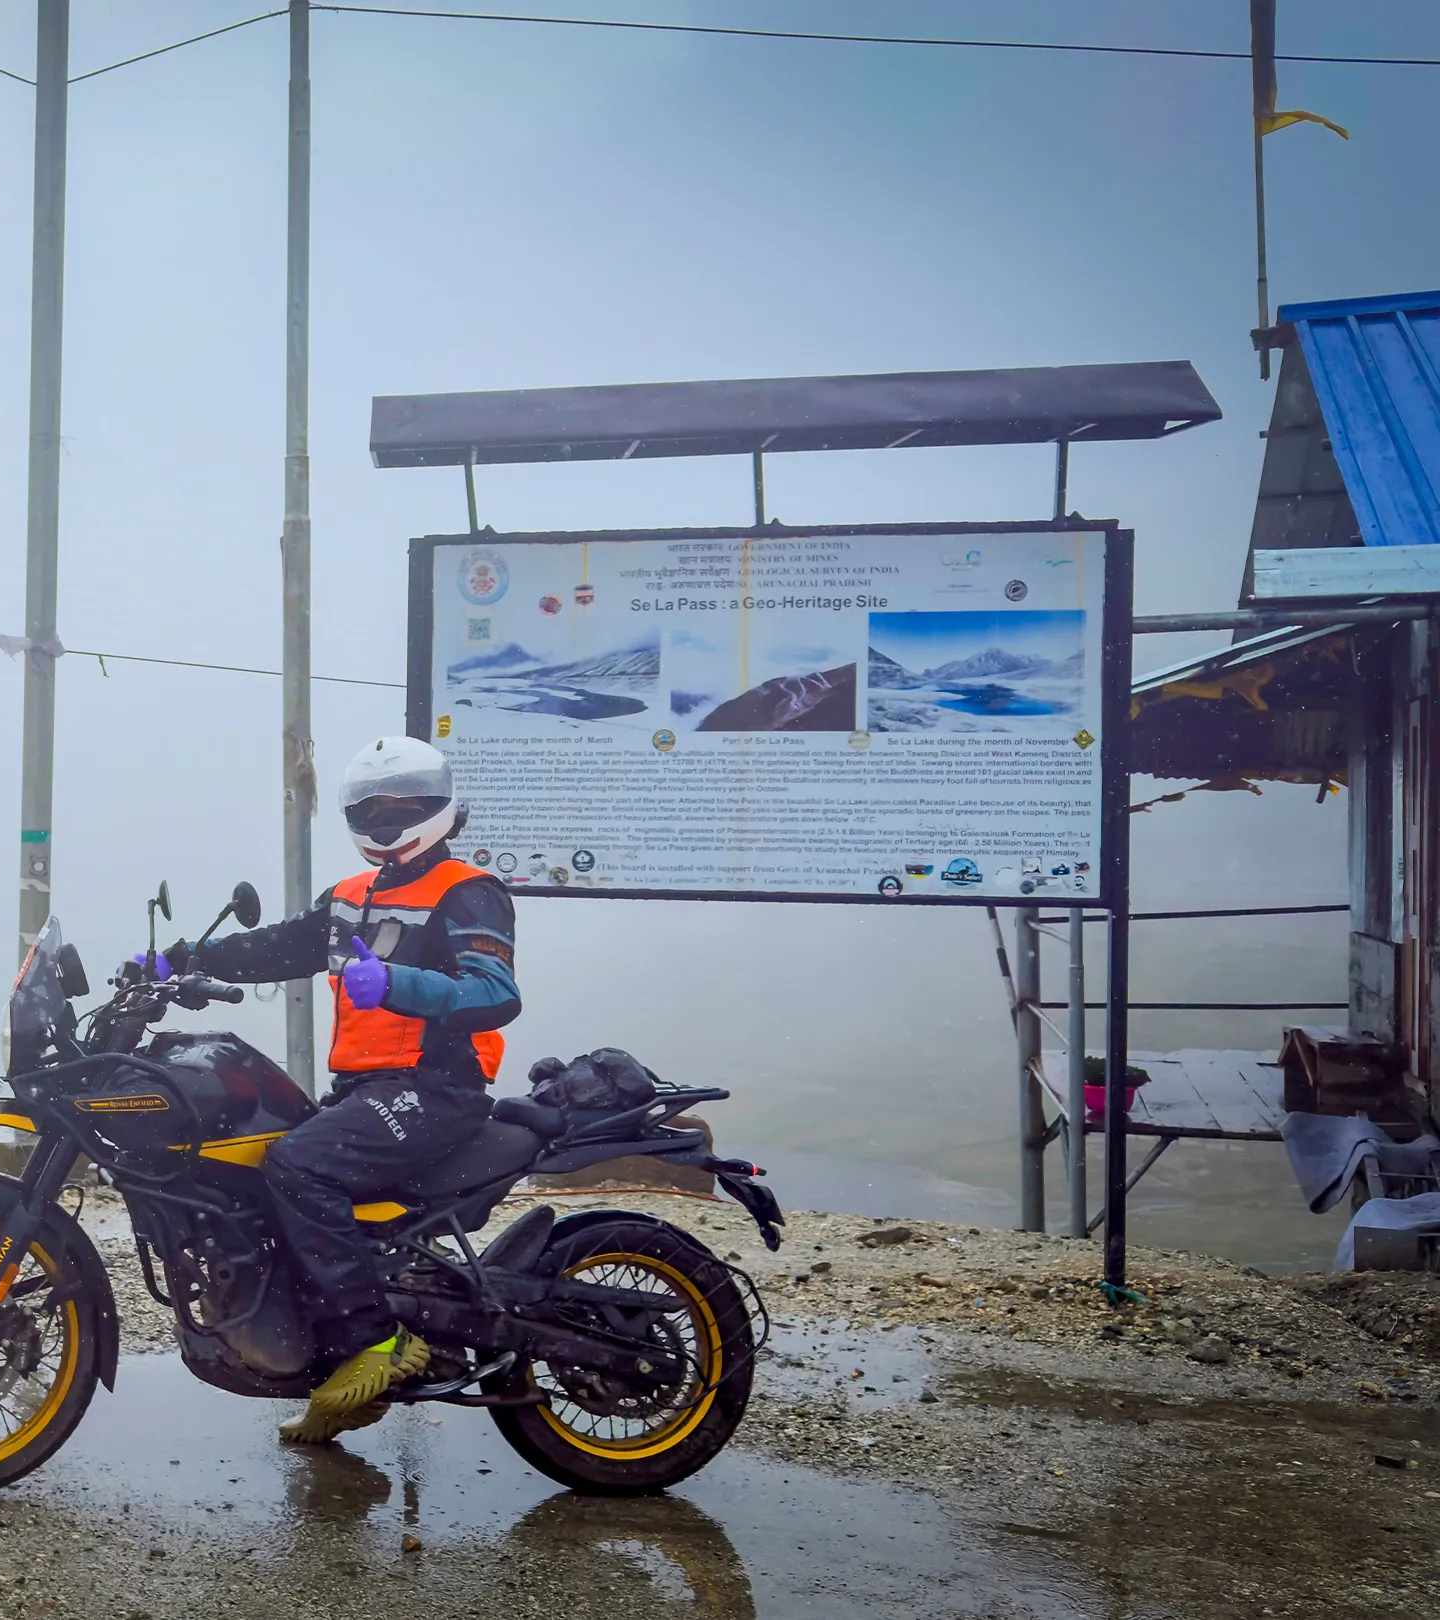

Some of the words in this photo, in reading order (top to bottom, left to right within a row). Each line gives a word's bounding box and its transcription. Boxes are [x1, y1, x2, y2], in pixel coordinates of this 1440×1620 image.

[630, 598, 651, 611] Se
[655, 598, 674, 611] La
[678, 598, 718, 611] Pass
[730, 600, 739, 610] a
[742, 596, 852, 611] Geo-Heritage
[856, 594, 888, 608] Site
[456, 736, 467, 744] Se
[469, 736, 479, 744] La
[480, 736, 500, 744] Lake
[502, 736, 528, 745] during
[530, 736, 544, 744] the
[545, 736, 572, 744] month
[574, 736, 583, 744] of
[587, 736, 613, 744] March
[937, 738, 965, 746] during
[907, 750, 938, 758] Tawang
[1014, 750, 1049, 758] Kameng
[993, 768, 1020, 776] glacial
[906, 830, 948, 838] belonging
